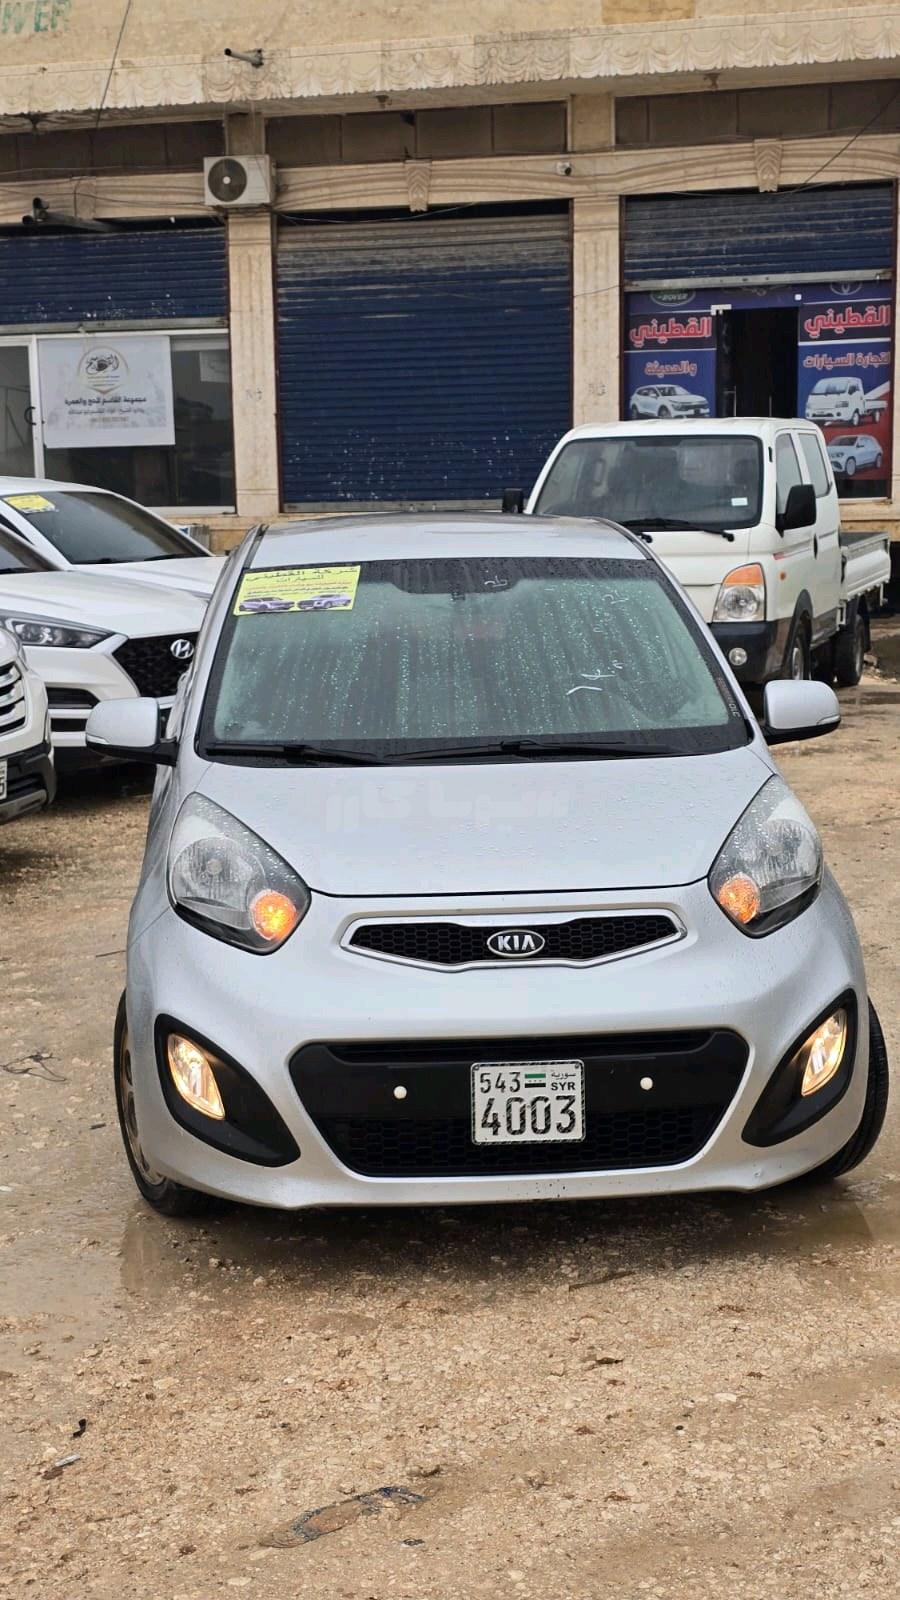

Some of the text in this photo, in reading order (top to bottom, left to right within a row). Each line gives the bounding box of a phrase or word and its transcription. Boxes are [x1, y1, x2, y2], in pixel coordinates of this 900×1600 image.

[804, 305, 891, 339] القطيني
[629, 316, 712, 348] القطيني
[645, 360, 697, 378] والحديثة
[803, 353, 855, 370] السيارات
[497, 934, 536, 951] KIA
[480, 1071, 521, 1093] 543
[551, 1071, 576, 1081] سورية
[550, 1081, 576, 1092] SYR
[481, 1095, 576, 1136] 4003
